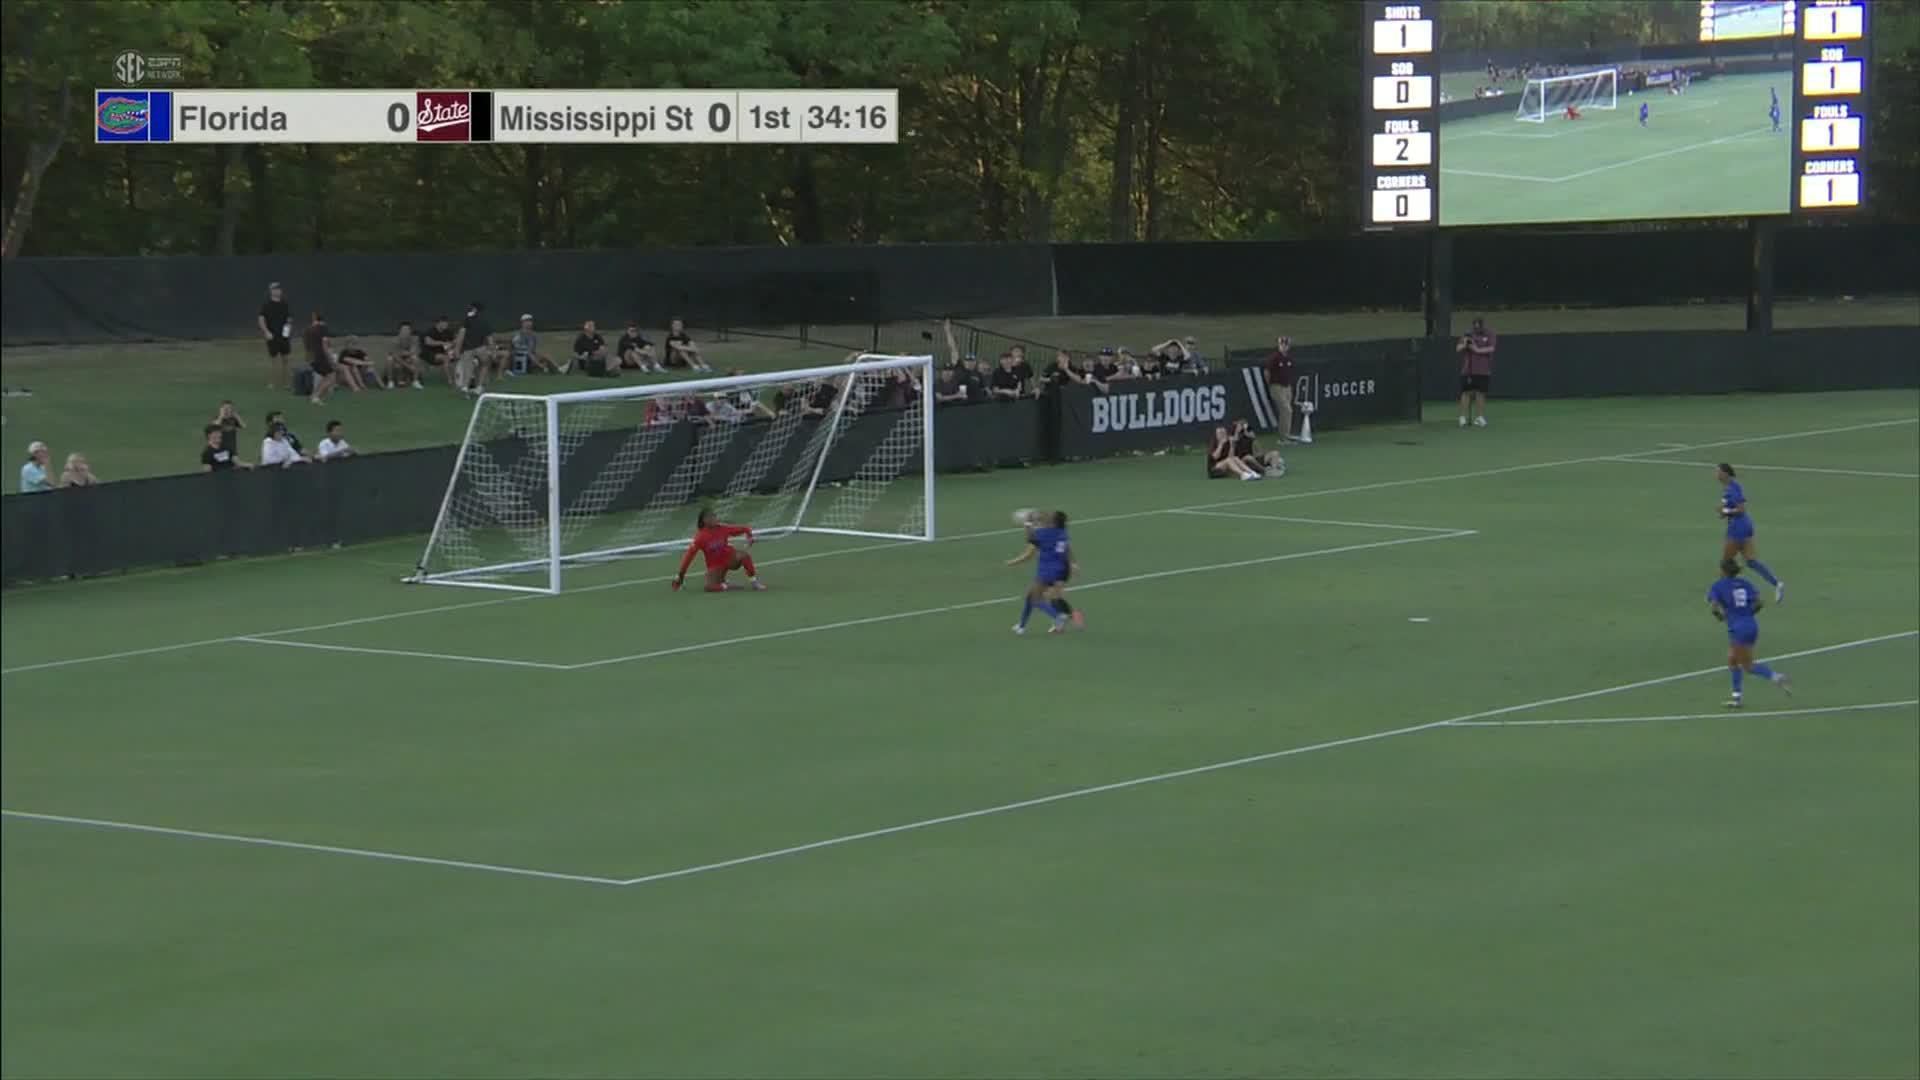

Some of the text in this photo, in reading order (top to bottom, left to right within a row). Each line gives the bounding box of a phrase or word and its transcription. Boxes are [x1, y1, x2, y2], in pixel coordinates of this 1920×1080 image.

[1831, 11, 1837, 33] 1
[1400, 24, 1407, 48] 1
[1829, 66, 1835, 89] 1
[1396, 81, 1409, 103] 0
[1828, 123, 1834, 146] 1
[1396, 139, 1409, 161] 2
[1827, 179, 1833, 202] 1
[1396, 195, 1409, 217] 0
[1323, 379, 1375, 398] SOCCER
[1091, 384, 1226, 433] BULLDOGS
